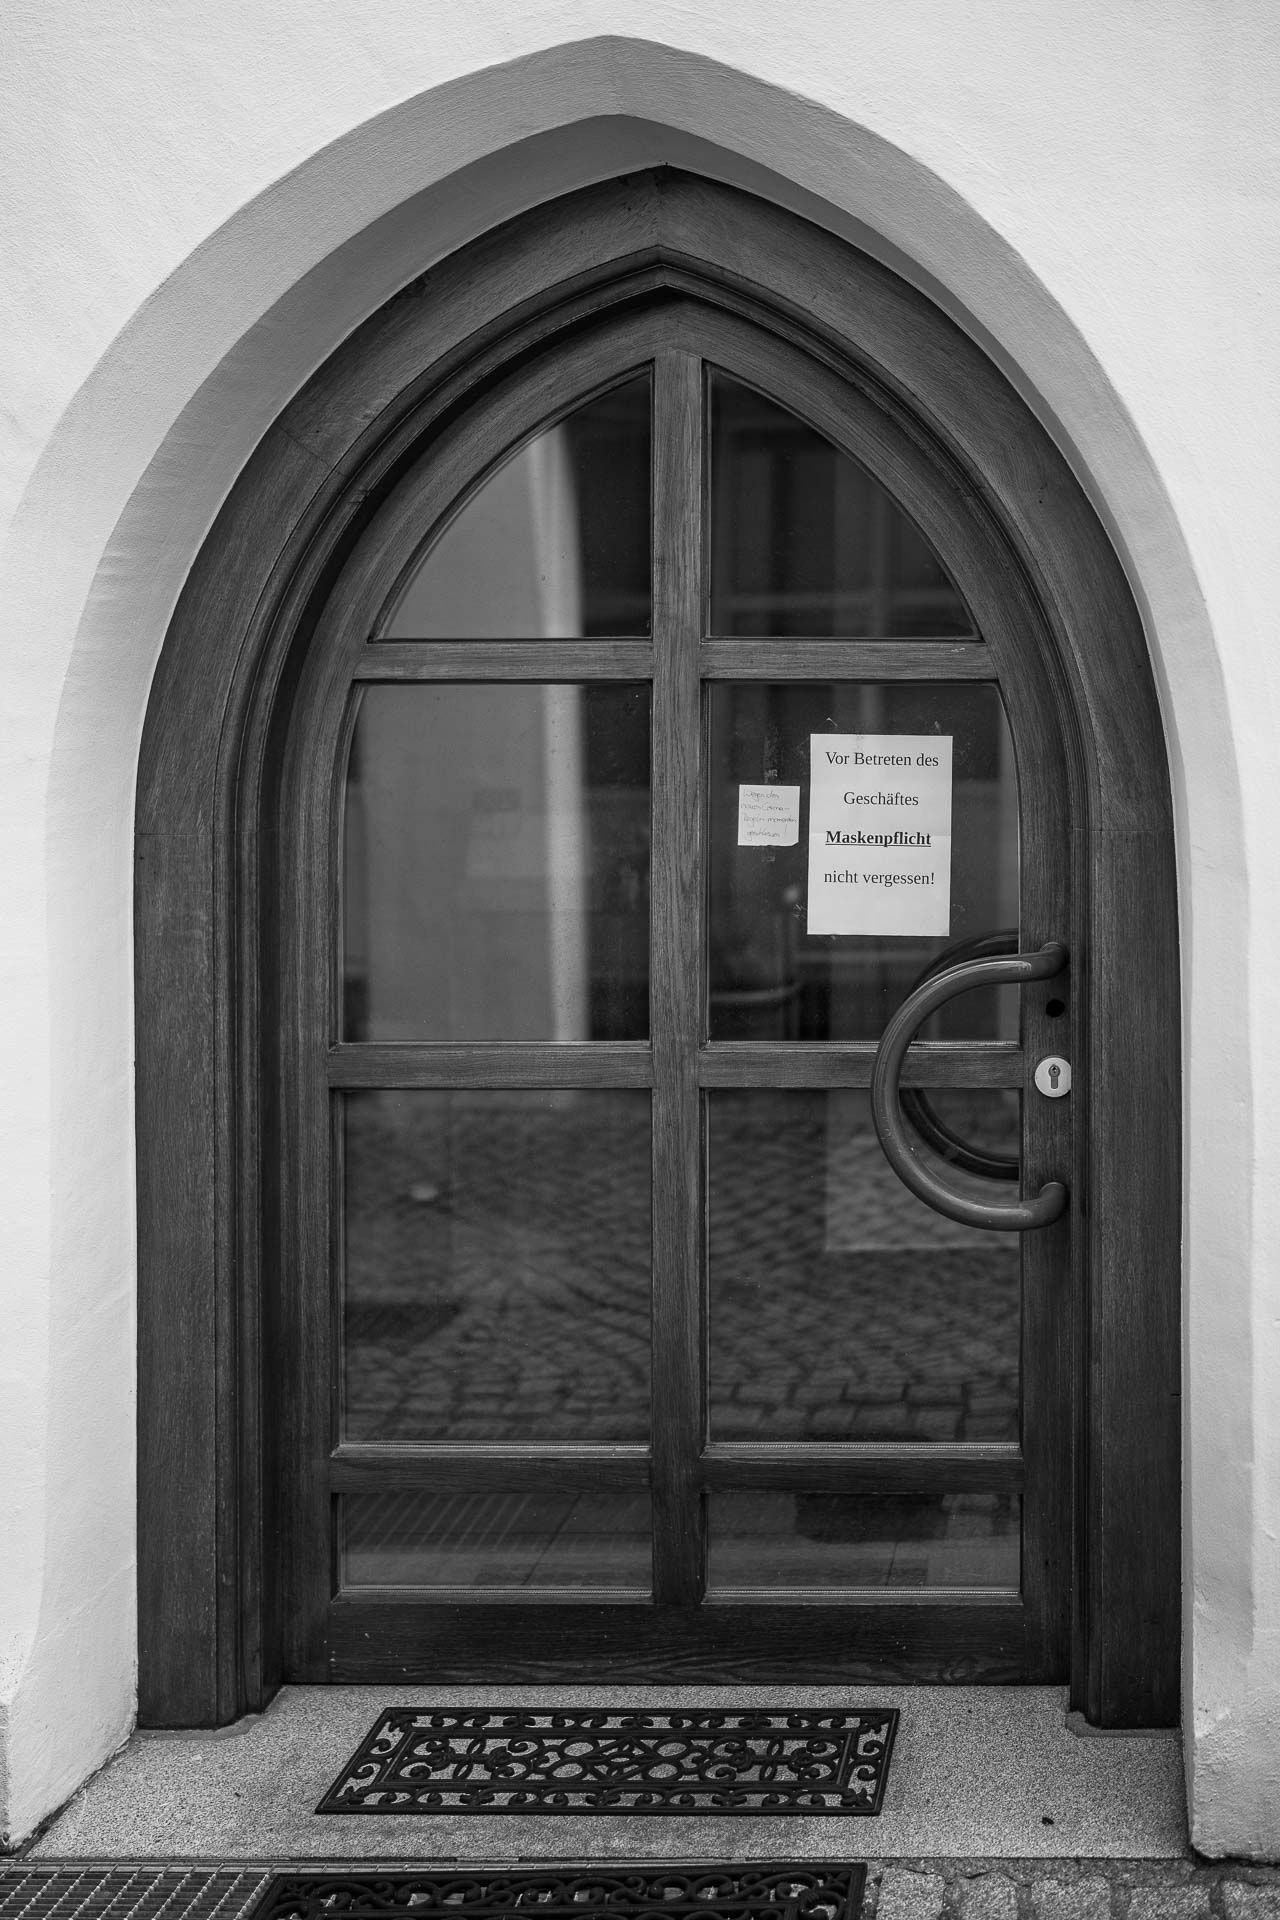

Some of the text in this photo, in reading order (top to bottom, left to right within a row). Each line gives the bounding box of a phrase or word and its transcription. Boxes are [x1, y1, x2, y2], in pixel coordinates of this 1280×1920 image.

[826, 752, 938, 766] Vor Betreten des
[844, 792, 918, 805] Geschäftes
[825, 831, 931, 847] Maskenpflicht
[825, 870, 934, 887] nicht vergessen!
